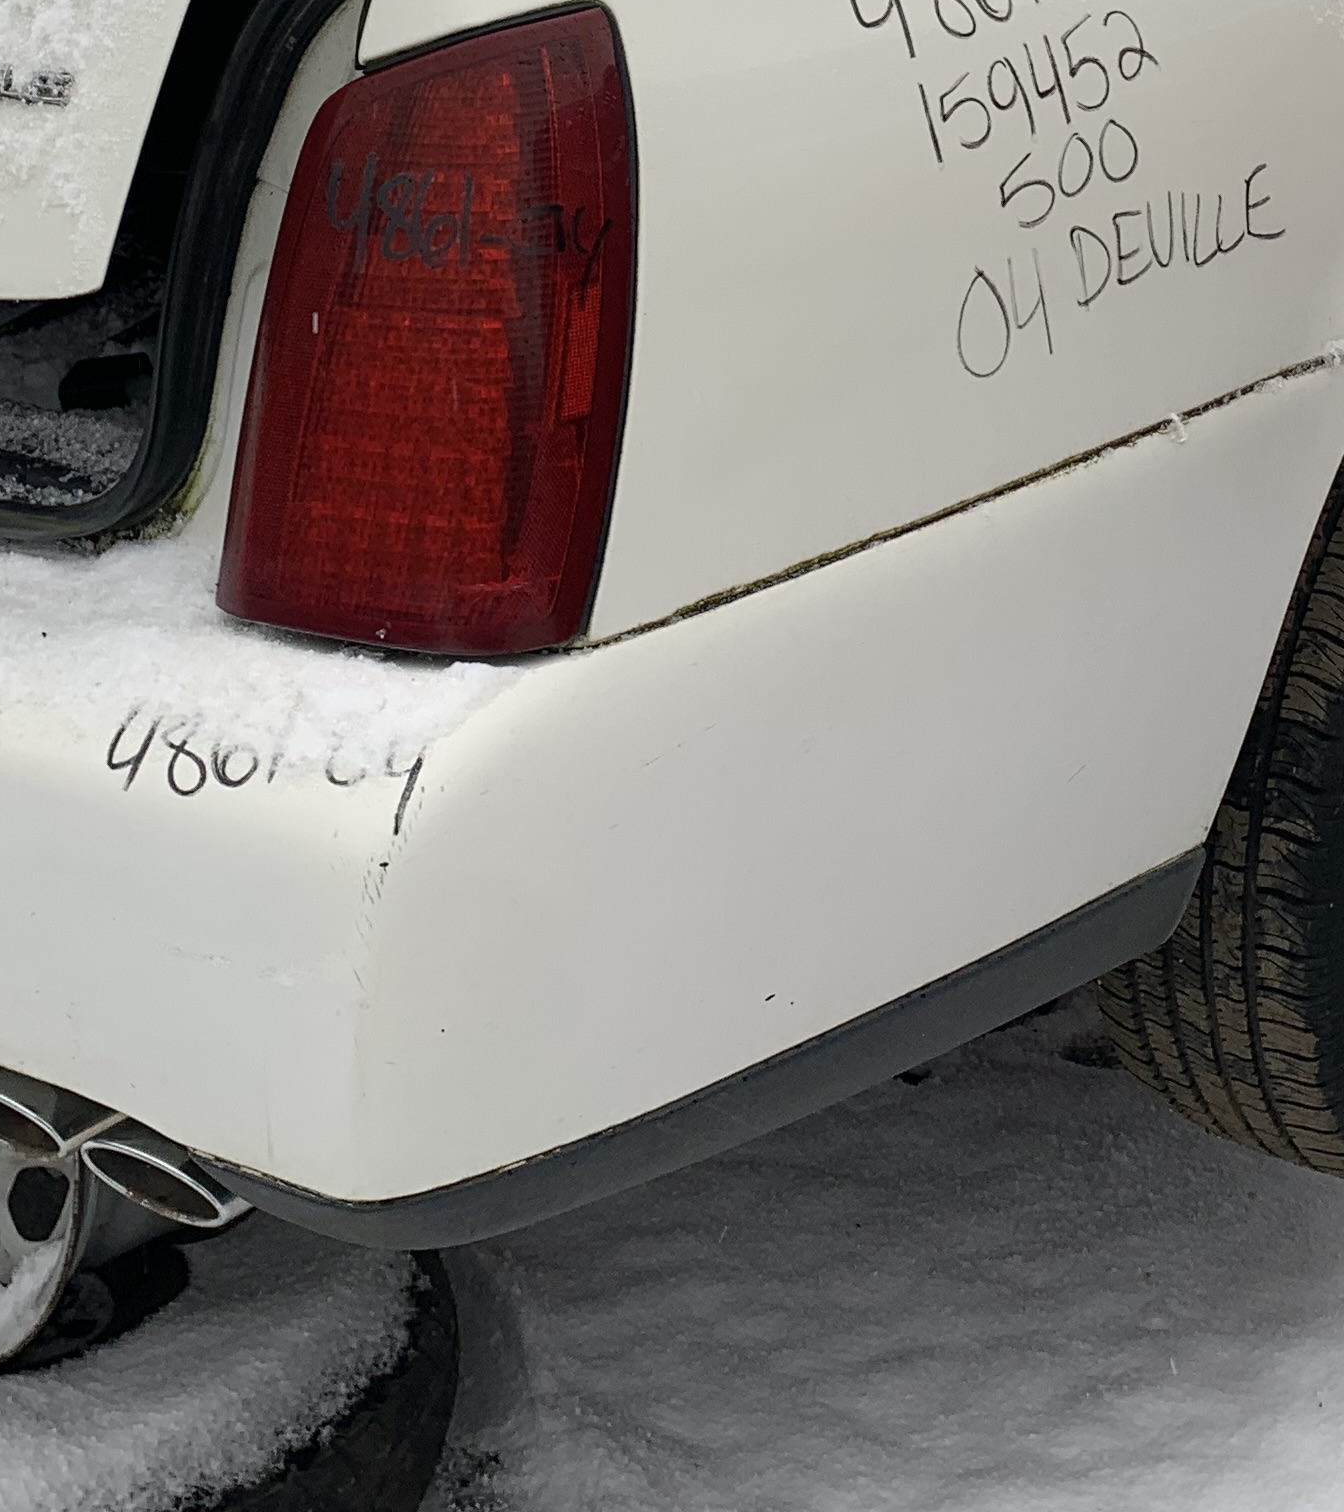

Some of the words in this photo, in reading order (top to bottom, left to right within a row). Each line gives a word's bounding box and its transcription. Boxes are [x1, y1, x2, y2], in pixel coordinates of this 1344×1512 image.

[917, 9, 1162, 167] 159452
[999, 118, 1139, 229] 500
[956, 246, 1055, 379] 04
[1068, 162, 1288, 310] DEVILLE
